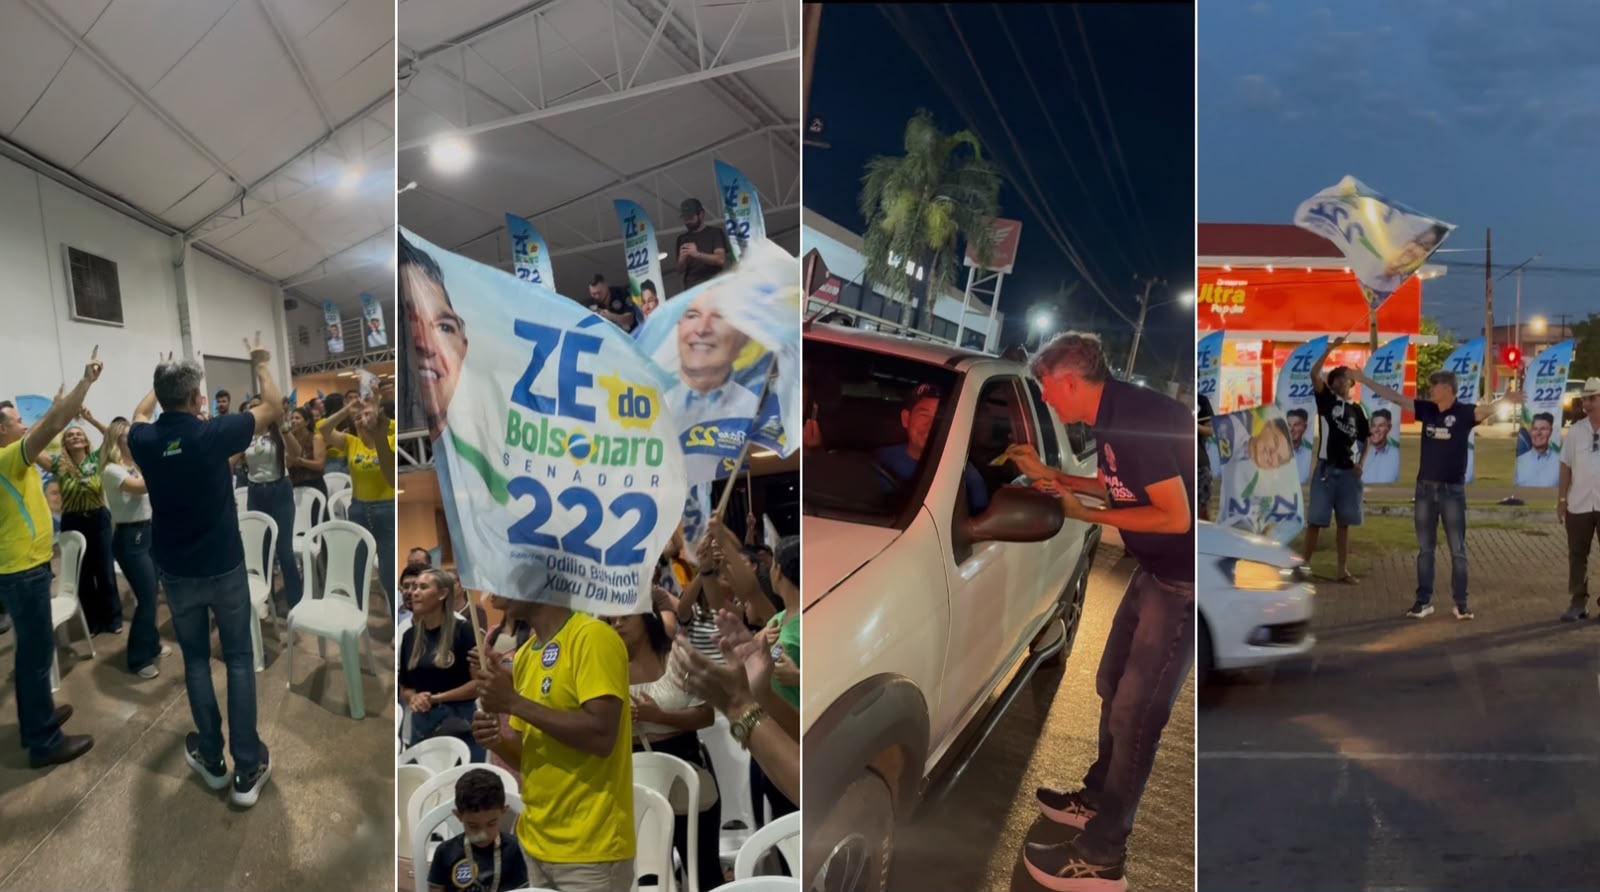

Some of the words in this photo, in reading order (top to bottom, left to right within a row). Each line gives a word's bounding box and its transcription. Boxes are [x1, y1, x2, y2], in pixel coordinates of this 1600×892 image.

[624, 209, 638, 239] ZÉ
[627, 248, 648, 270] 222
[510, 314, 604, 423] ZÉ
[618, 387, 651, 419] do
[1291, 350, 1313, 372] ZÉ
[1373, 351, 1394, 373] ZÉ
[1453, 352, 1471, 374] ZÉ
[1537, 354, 1557, 377] ZÉ
[505, 408, 664, 467] Bolsonaro
[502, 452, 660, 488] SENADOR
[506, 476, 658, 566] 222
[544, 573, 582, 595] Xuxu
[585, 582, 608, 602] Dal
